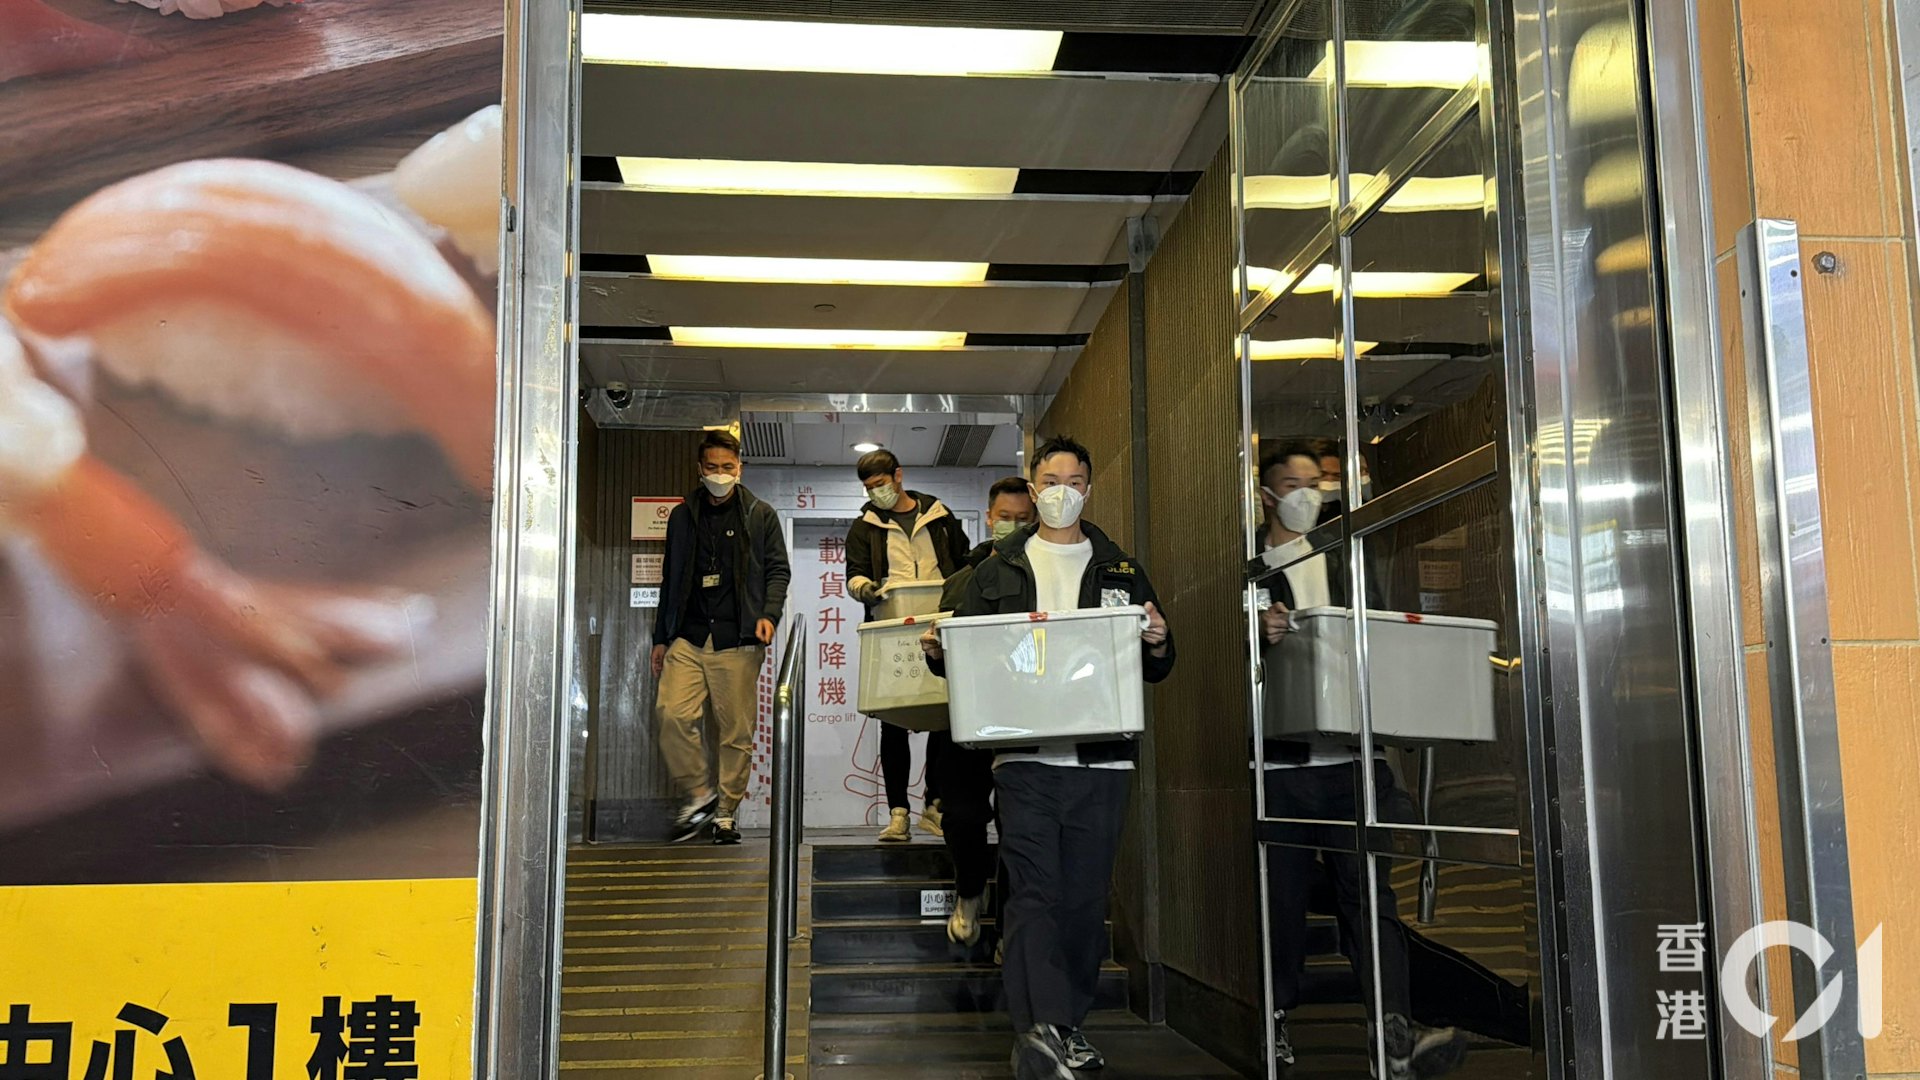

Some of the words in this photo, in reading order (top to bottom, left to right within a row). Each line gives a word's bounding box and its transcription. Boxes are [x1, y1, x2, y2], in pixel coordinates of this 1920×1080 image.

[798, 486, 813, 494] Lift
[797, 495, 816, 509] S1
[1107, 567, 1135, 575] OLICE
[633, 590, 657, 599] 小心地
[818, 536, 847, 706] 載貨升降機
[807, 712, 842, 725] Cargo
[844, 712, 857, 723] lift
[924, 893, 953, 904] 小心地
